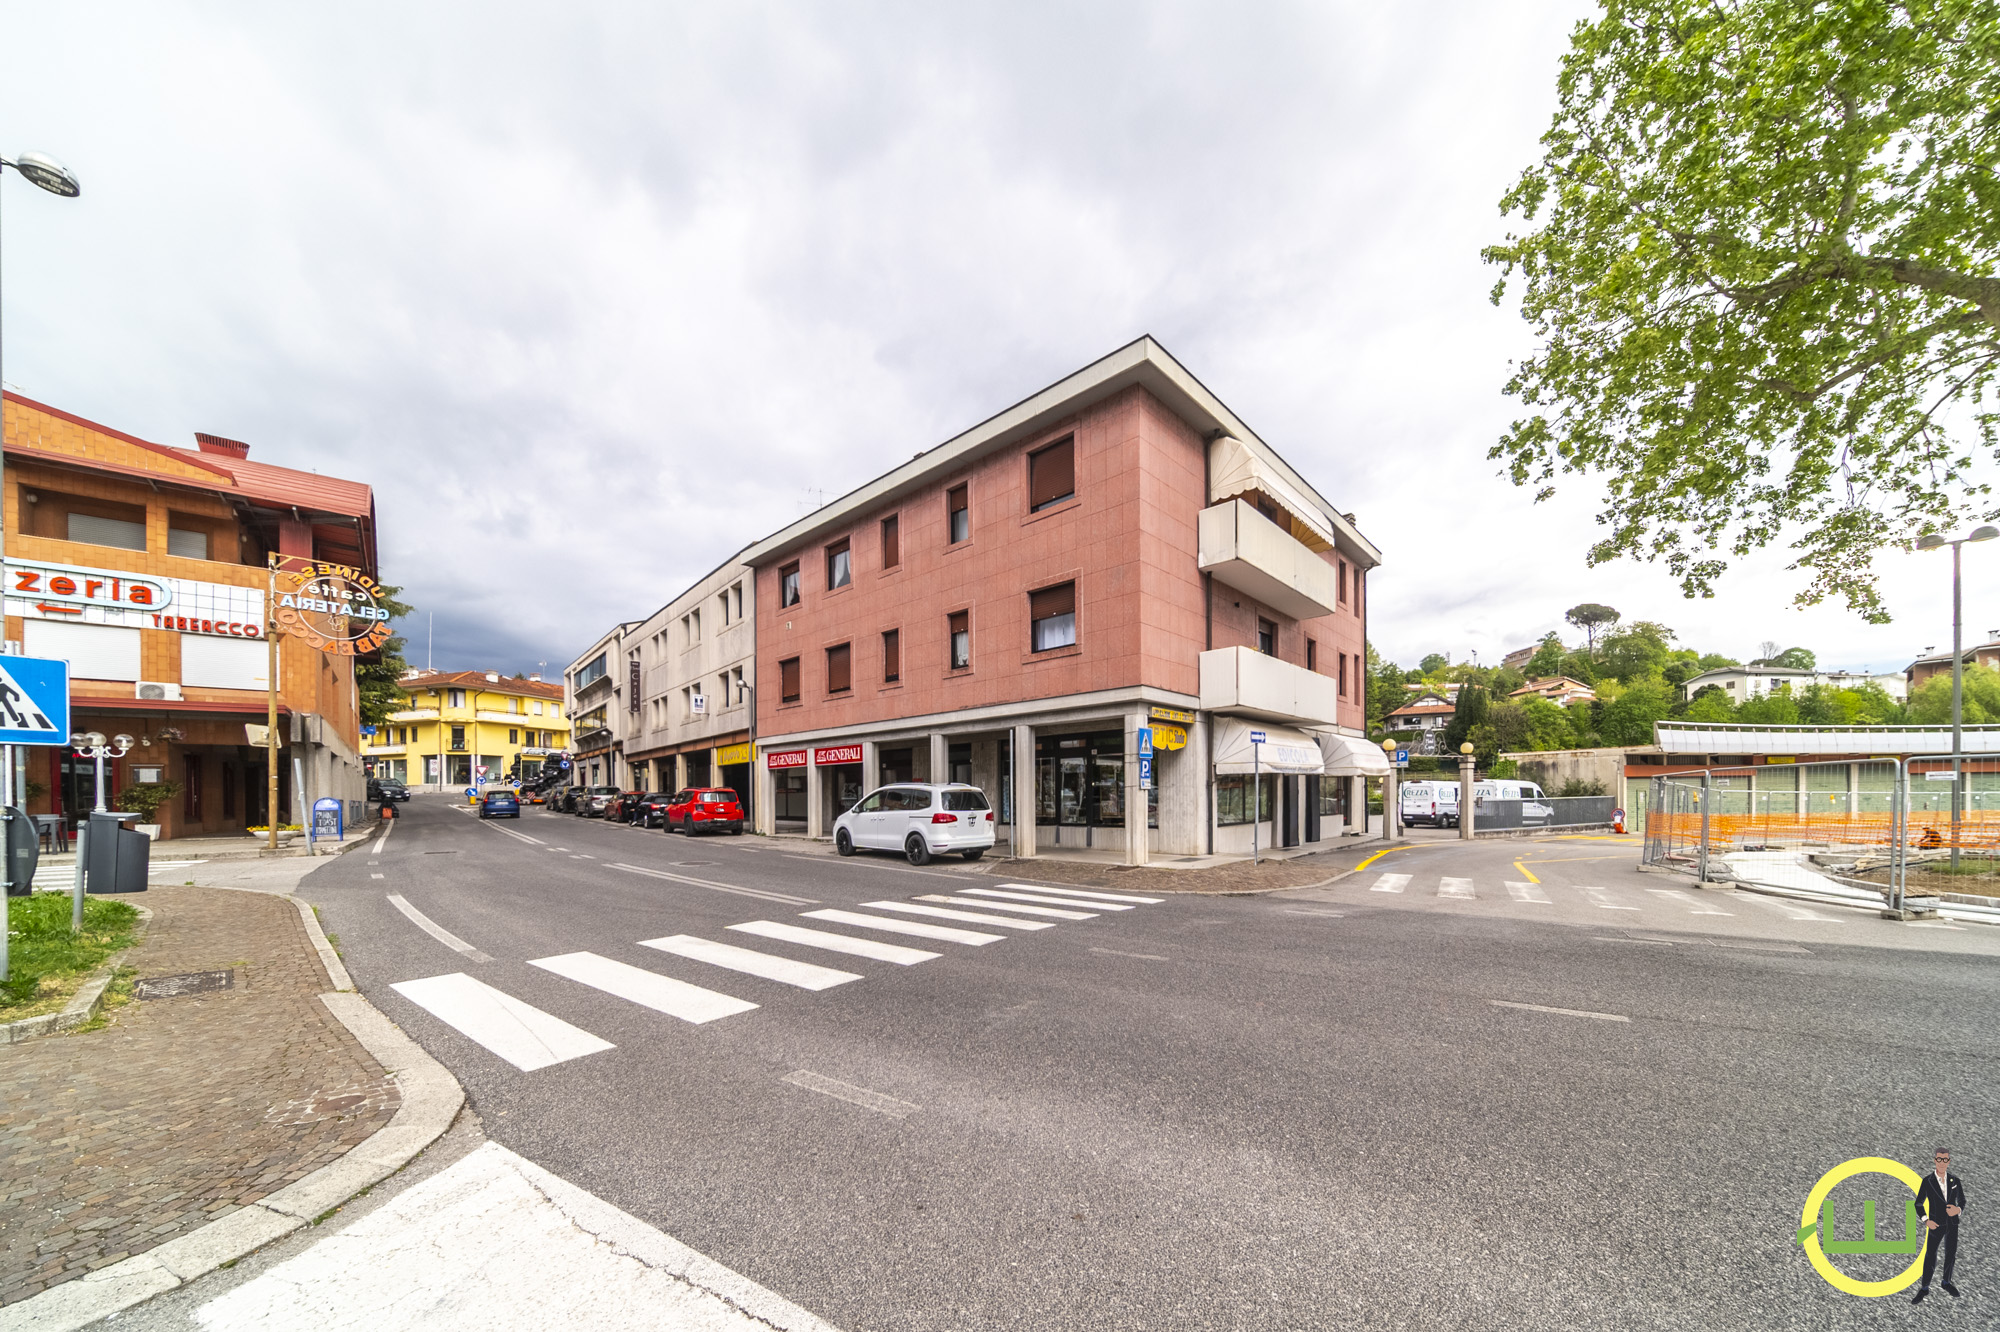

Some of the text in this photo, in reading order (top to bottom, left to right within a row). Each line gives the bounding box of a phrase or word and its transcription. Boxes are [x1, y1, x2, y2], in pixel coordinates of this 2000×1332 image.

[15, 571, 152, 604] zeria
[777, 753, 806, 766] GENERALI
[826, 747, 861, 761] GENERALI
[1277, 747, 1310, 763] EDICOLA
[1398, 752, 1406, 760] P
[1142, 761, 1149, 777] P
